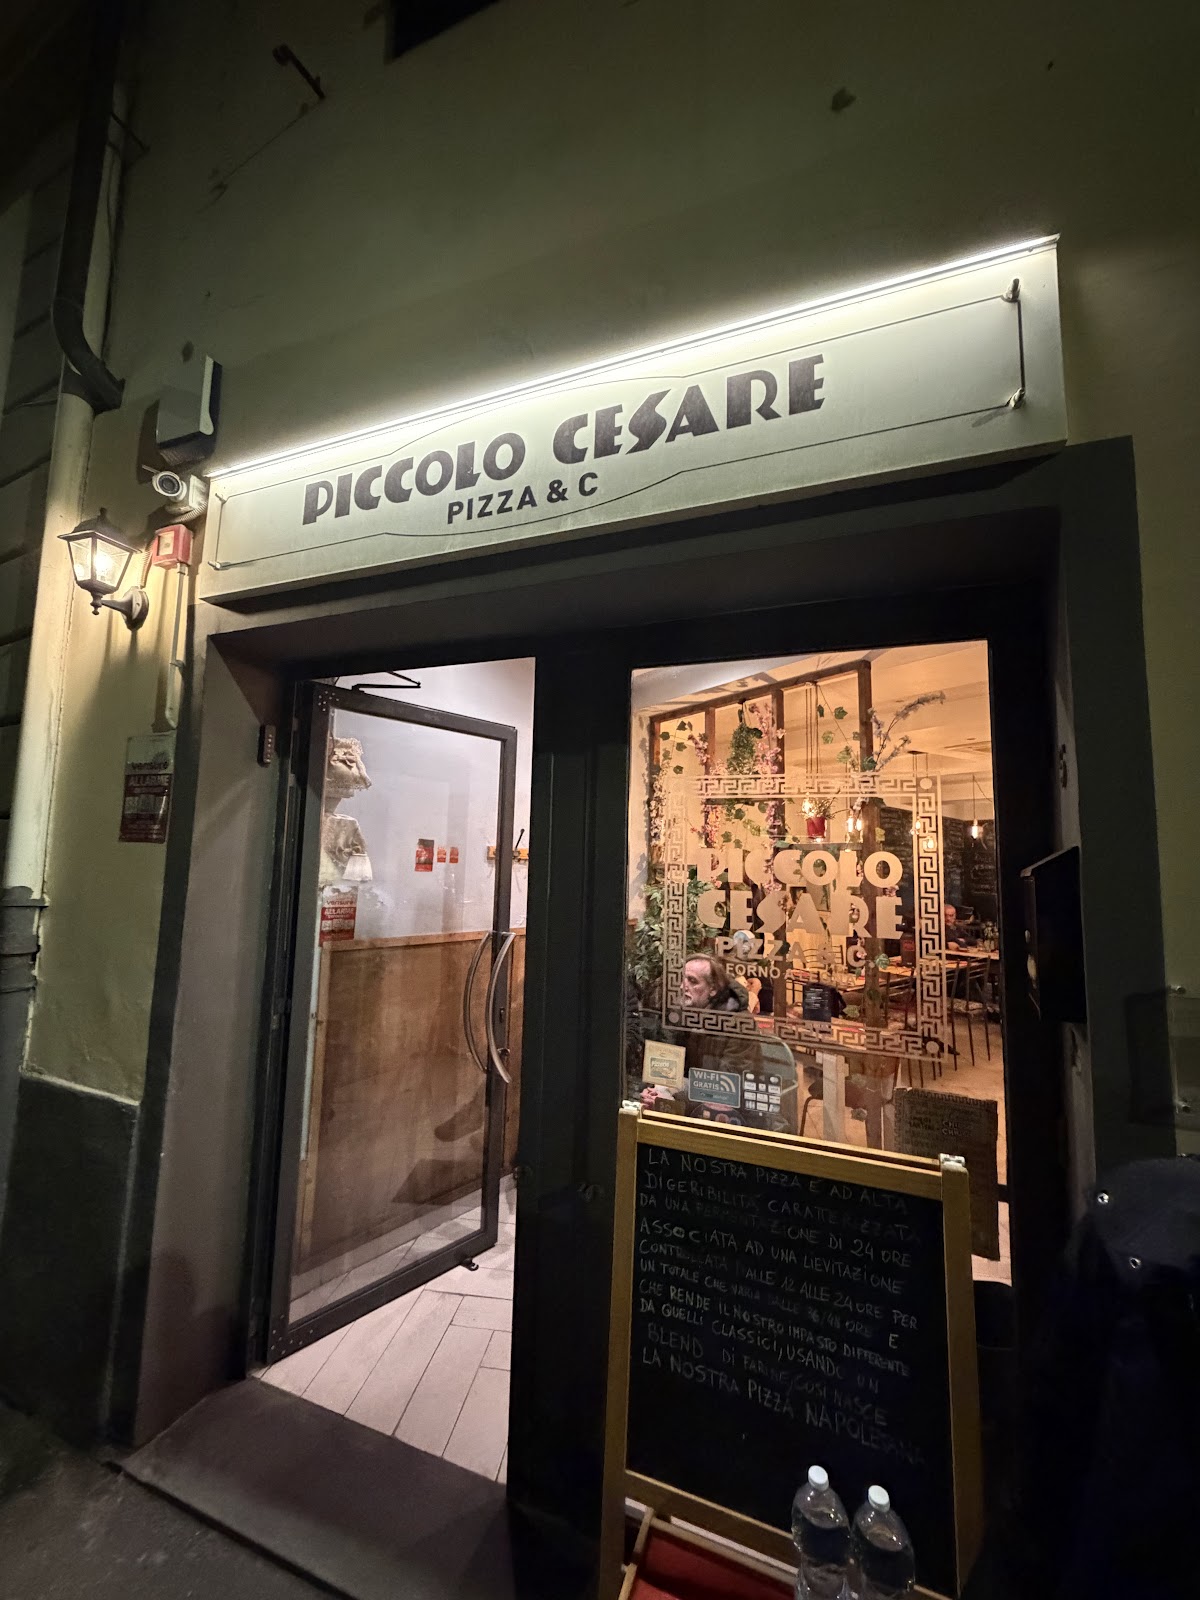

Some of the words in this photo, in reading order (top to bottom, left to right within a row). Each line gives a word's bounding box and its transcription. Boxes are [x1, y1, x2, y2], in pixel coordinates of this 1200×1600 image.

[302, 432, 526, 525] PICCOLO
[553, 353, 826, 464] CESARE
[446, 486, 539, 525] PIZZA
[545, 480, 569, 505] &
[578, 472, 598, 499] C
[697, 848, 903, 888] PICCOLO
[697, 890, 903, 939] CESARE
[716, 936, 807, 965] PIZZA
[693, 1070, 719, 1082] WI-FI
[693, 1081, 719, 1091] GRATIS
[648, 1148, 670, 1166] LA
[680, 1154, 747, 1179] NOSTRA
[756, 1167, 801, 1188] PIZZA
[830, 1184, 853, 1201] AD
[639, 1192, 657, 1207] DA
[665, 1195, 690, 1215] UNA
[828, 1232, 844, 1250] DI
[850, 1238, 874, 1262] 24
[880, 1249, 912, 1268] ORE
[639, 1217, 738, 1253] ASSOCIATA
[744, 1240, 765, 1256] AD
[771, 1245, 797, 1264] UNA
[803, 1255, 905, 1295] LIEVITAZIONE
[639, 1279, 664, 1297] CHE
[669, 1285, 711, 1311] RENDE
[718, 1303, 730, 1316] IL
[733, 1304, 785, 1335] NOSTRO
[788, 1324, 838, 1353] IMPASTO
[843, 1343, 912, 1377] DIFFERENTE
[640, 1258, 655, 1273] UN
[660, 1262, 699, 1284] TOTALE
[704, 1275, 728, 1293] CHE
[845, 1319, 872, 1338] ORE
[888, 1333, 900, 1349] E
[781, 1276, 795, 1293] 12
[800, 1281, 832, 1302] ALLE
[833, 1292, 854, 1312] 24
[855, 1302, 884, 1319] ORE
[892, 1309, 919, 1331] PER
[640, 1297, 655, 1314] DA
[661, 1303, 704, 1326] QUELLI
[857, 1375, 880, 1394] UN
[647, 1322, 704, 1359] BLEND
[722, 1346, 735, 1366] DI
[642, 1346, 662, 1367] LA
[670, 1353, 741, 1395] NOSTRA
[747, 1378, 795, 1418] PIZZA
